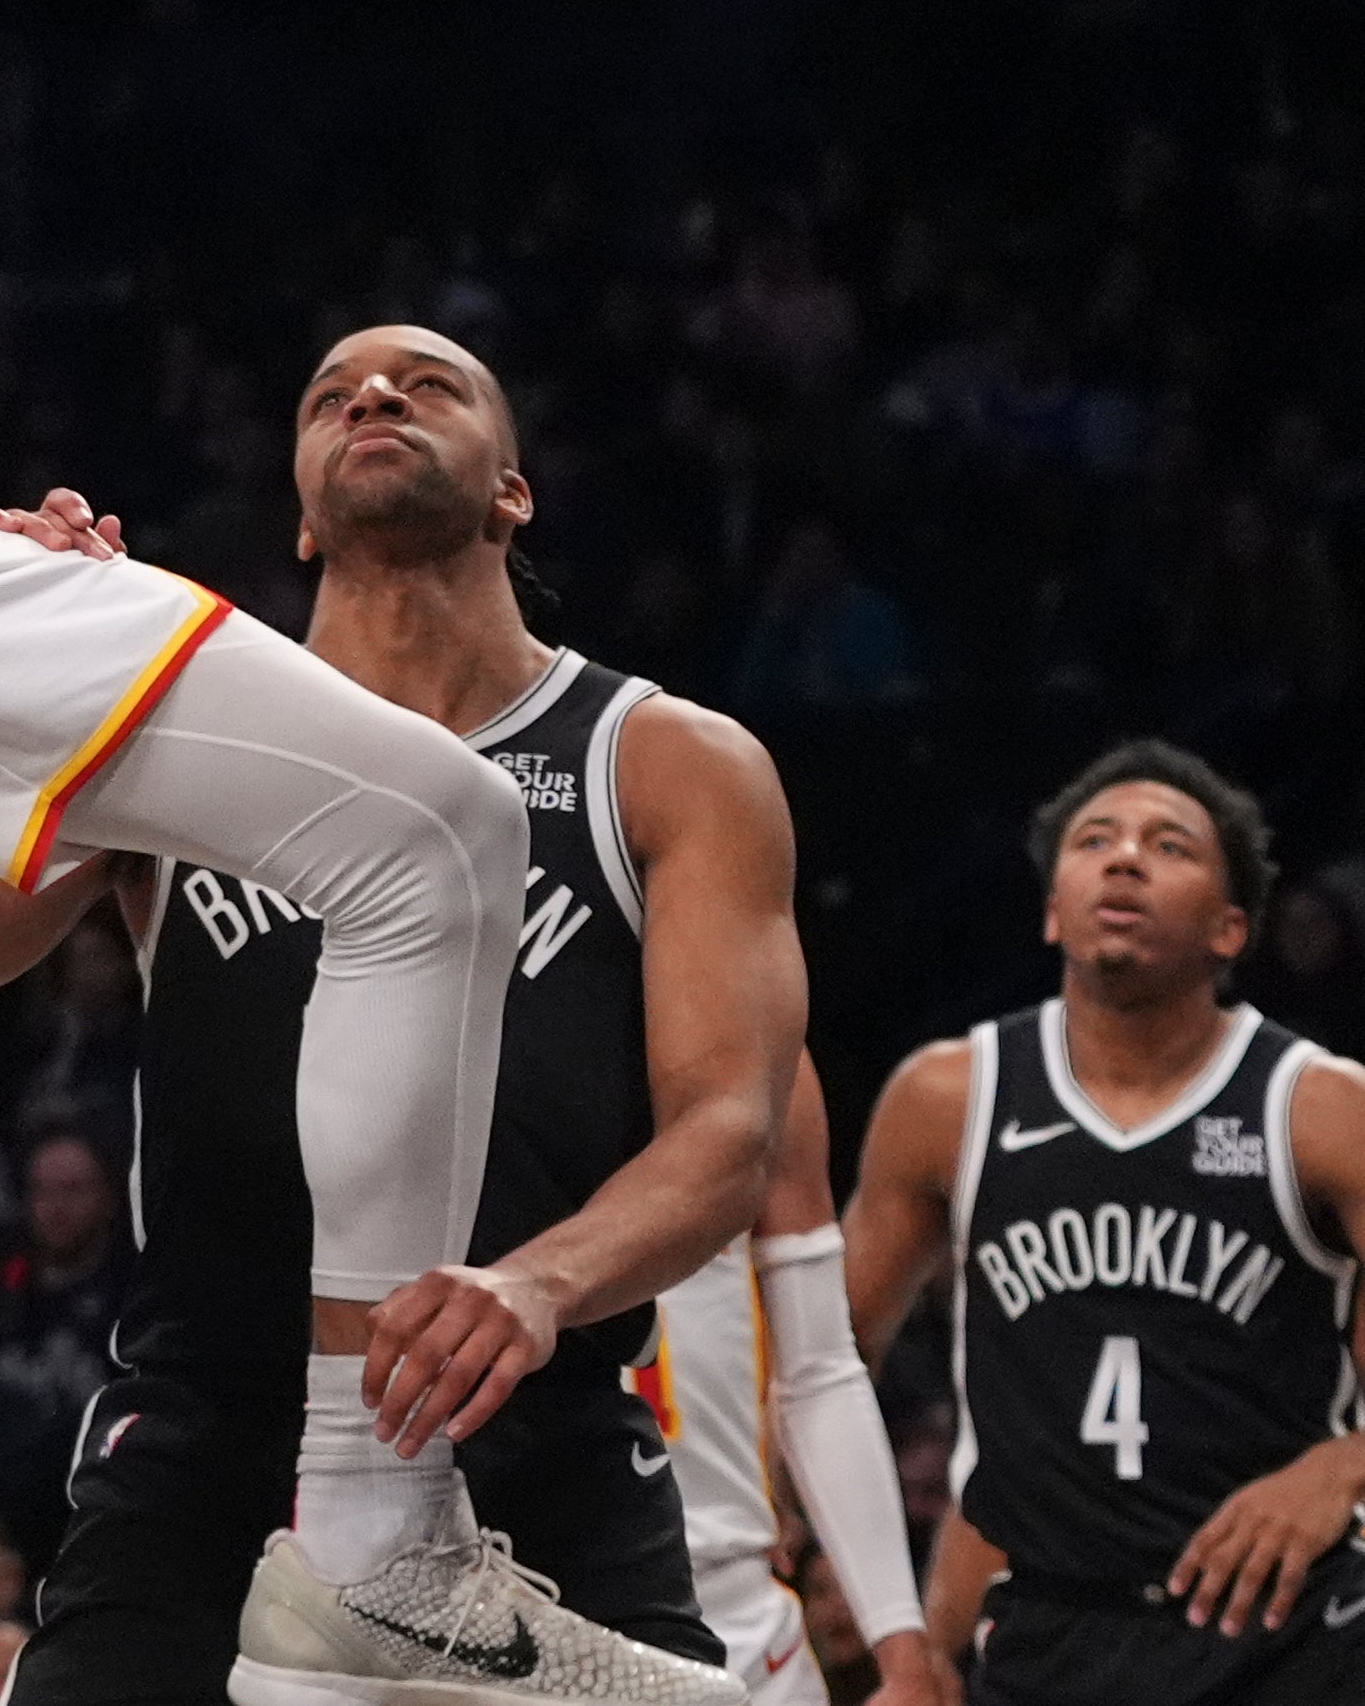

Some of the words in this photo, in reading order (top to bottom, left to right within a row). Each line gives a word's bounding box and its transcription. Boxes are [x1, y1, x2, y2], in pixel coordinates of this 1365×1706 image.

[515, 770, 576, 791] OUR
[523, 788, 578, 812] IDE
[977, 1202, 1285, 1325] BROOKLYN
[1080, 1335, 1150, 1480] 4
